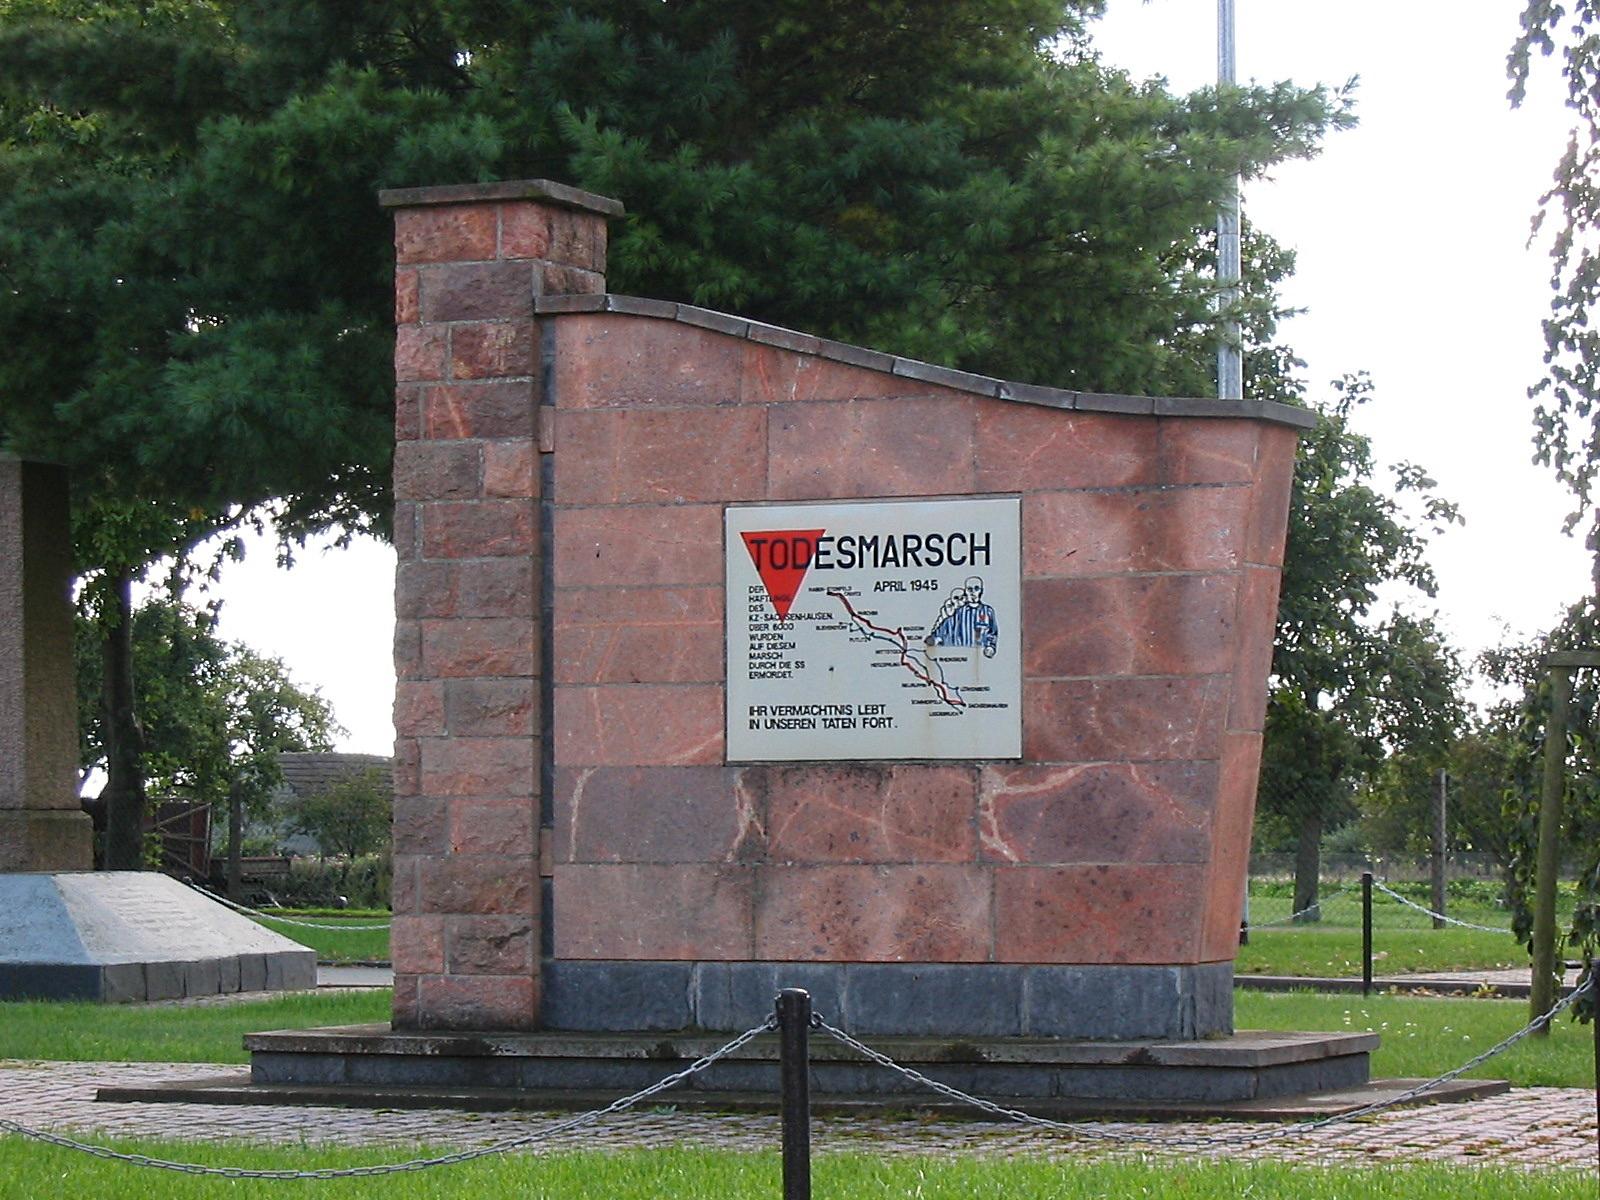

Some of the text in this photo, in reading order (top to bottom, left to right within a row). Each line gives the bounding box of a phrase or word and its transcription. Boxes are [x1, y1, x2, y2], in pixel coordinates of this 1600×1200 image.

[750, 532, 991, 571] TODESMARSCH
[748, 585, 764, 594] DER
[873, 579, 938, 593] APRIL 1945
[748, 604, 765, 613] DES
[772, 622, 795, 631] 6000
[749, 632, 784, 641] WURDEN
[749, 641, 796, 651] AUF DIESEM
[748, 651, 783, 660] MARSCH
[748, 660, 806, 670] DURCH DIE SS
[748, 670, 794, 680] ERMORDET.
[749, 705, 768, 717] IHR
[857, 704, 887, 716] LEBT
[749, 718, 760, 730] IN
[764, 717, 817, 730] UNSEREN
[821, 717, 857, 729] TATEN
